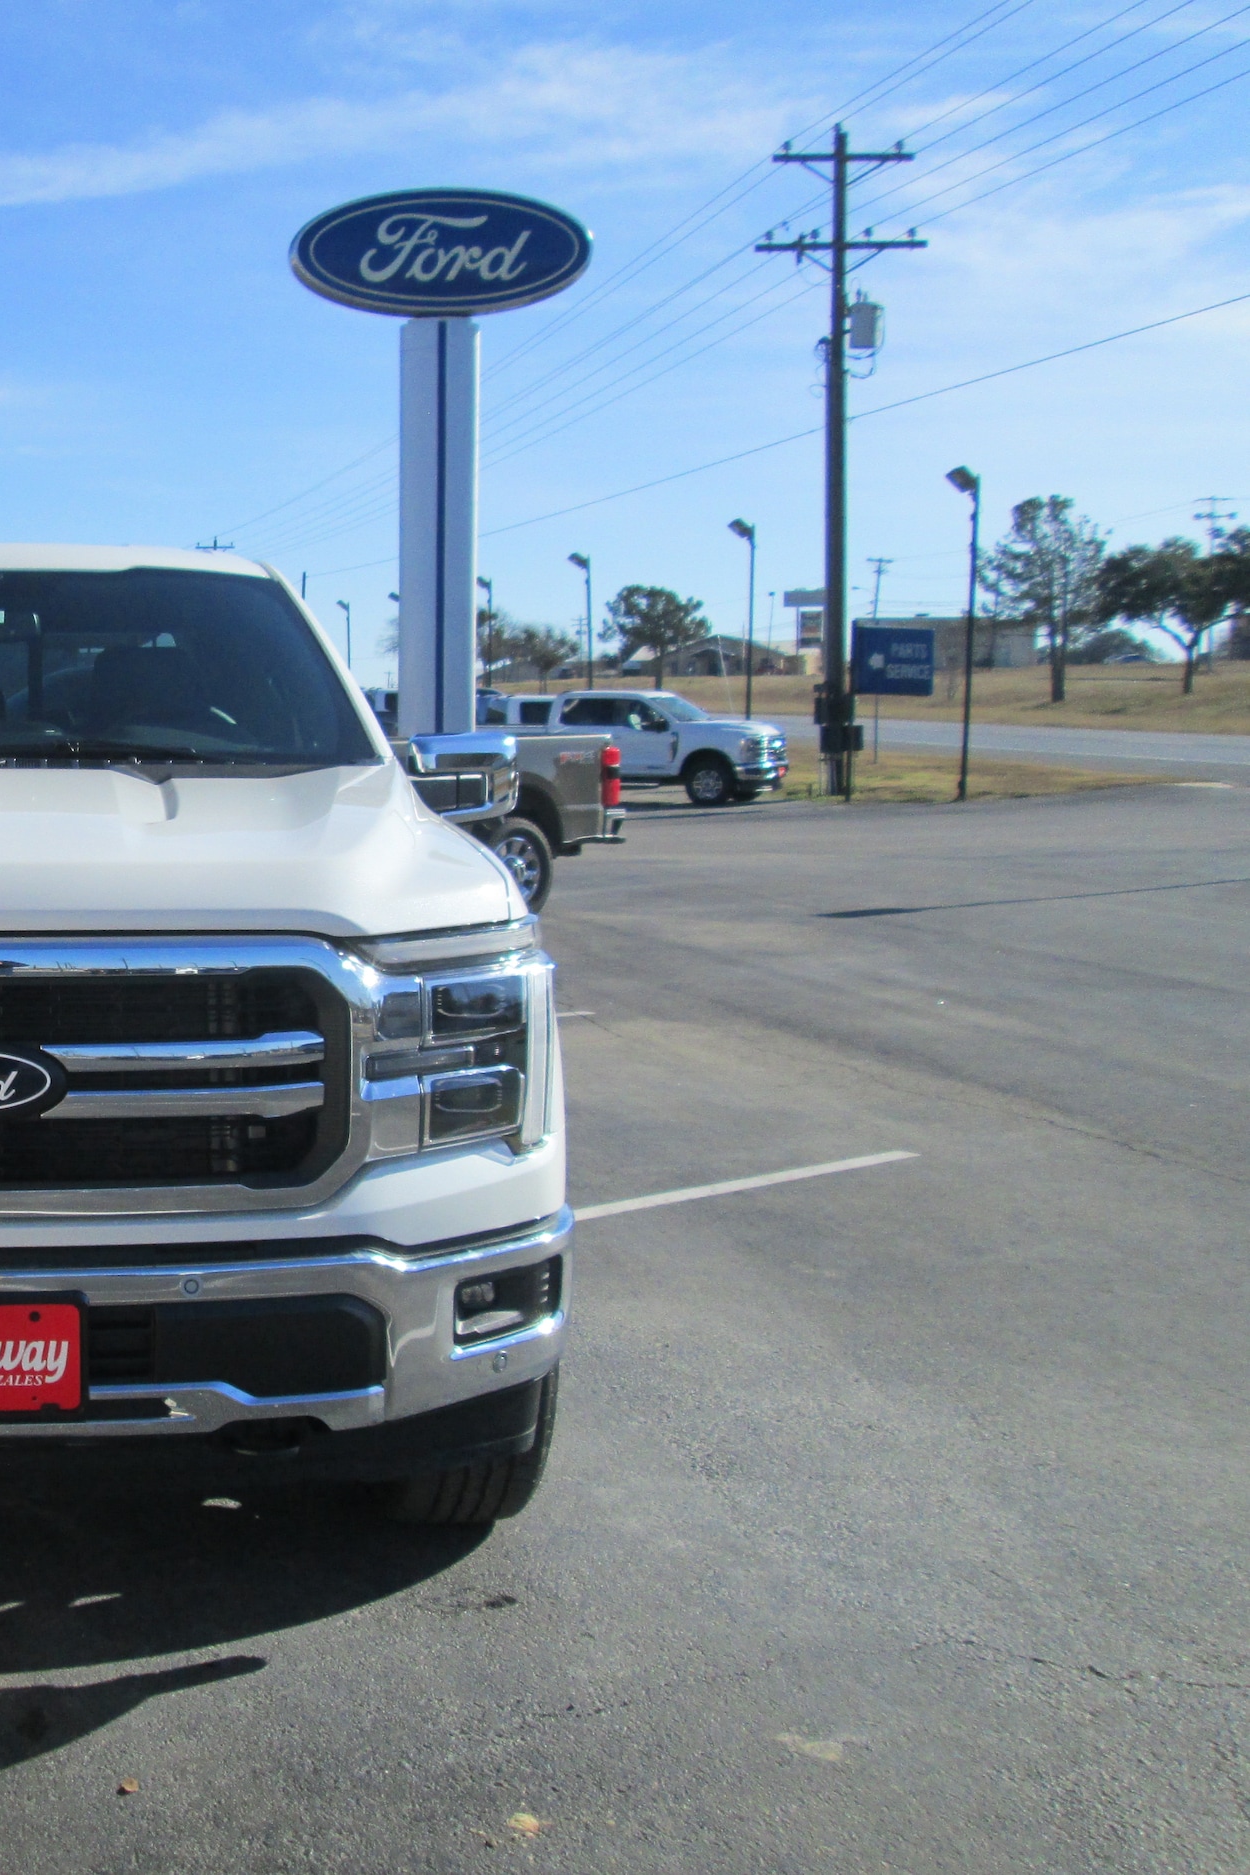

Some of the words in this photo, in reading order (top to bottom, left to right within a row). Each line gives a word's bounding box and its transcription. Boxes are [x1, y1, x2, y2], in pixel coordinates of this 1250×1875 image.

[360, 212, 532, 283] Ford
[891, 642, 928, 659] PARTS
[885, 663, 931, 680] SERVICE
